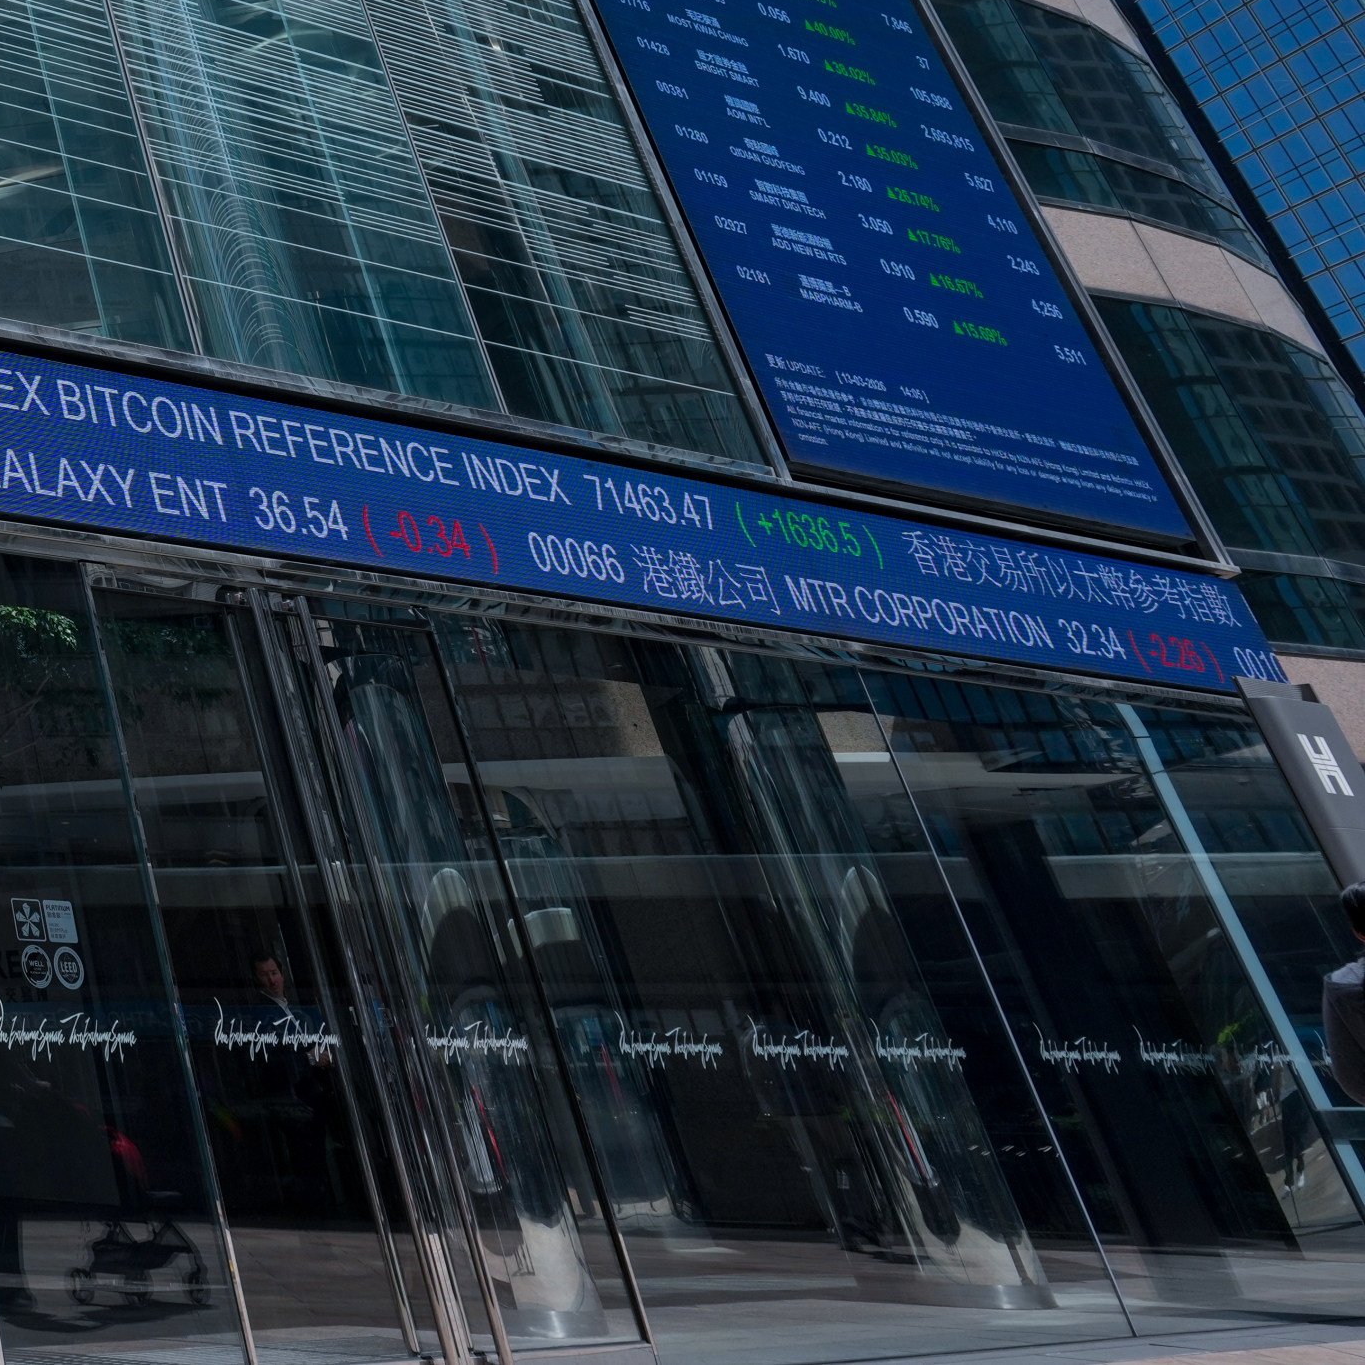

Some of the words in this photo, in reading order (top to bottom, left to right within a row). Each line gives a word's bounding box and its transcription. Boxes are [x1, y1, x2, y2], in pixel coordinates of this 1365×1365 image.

[757, 1, 791, 24] 0.056
[880, 12, 913, 34] 7,846
[666, 12, 692, 29] MOST
[716, 29, 749, 47] CHUNG
[636, 35, 670, 56] 01428
[777, 43, 810, 64] 1.670
[915, 54, 930, 70] 37
[694, 59, 728, 78] BRIGHT
[728, 70, 760, 88] SMART
[655, 79, 689, 100] 00381
[796, 85, 831, 107] 9.400
[909, 86, 953, 110] 105,988
[725, 106, 748, 121] AOM
[674, 123, 709, 144] 01280
[817, 127, 853, 150] 0.212
[920, 124, 975, 152] 2,693,815
[760, 154, 806, 176] GUOFENG
[693, 167, 728, 188] 01159
[837, 170, 873, 193] 2.180
[963, 171, 995, 193] 5,627
[748, 189, 781, 207] SMART
[780, 198, 802, 213] DIGI
[799, 203, 827, 219] TECH
[713, 214, 747, 235] 02927
[857, 213, 893, 235] 3.050
[986, 213, 1018, 235] 4,110
[771, 236, 792, 251] ADD
[790, 242, 814, 257] NEW
[812, 247, 828, 260] EN
[826, 251, 847, 266] RTS
[735, 264, 771, 285] 02181
[879, 258, 916, 281] 0.910
[1006, 254, 1040, 276] 2,243
[799, 287, 863, 313] MABPHARM-B
[1031, 298, 1063, 319] 4,256
[902, 306, 939, 329] 0.590
[1053, 344, 1087, 365] 5,511
[56, 379, 223, 445] BITCOIN
[229, 410, 459, 486] REFERENCE
[461, 452, 571, 505] INDEX
[583, 474, 713, 530] 71463.47
[148, 471, 227, 522] ENT
[249, 486, 349, 540] 36.54
[903, 531, 1240, 626] 香港交易所以太幣參考指數
[527, 531, 625, 584] 00066
[632, 545, 781, 613] 港鐵公司
[784, 574, 855, 619] MTR
[854, 586, 1053, 648] CORPORATION
[1057, 618, 1127, 660] 32.34
